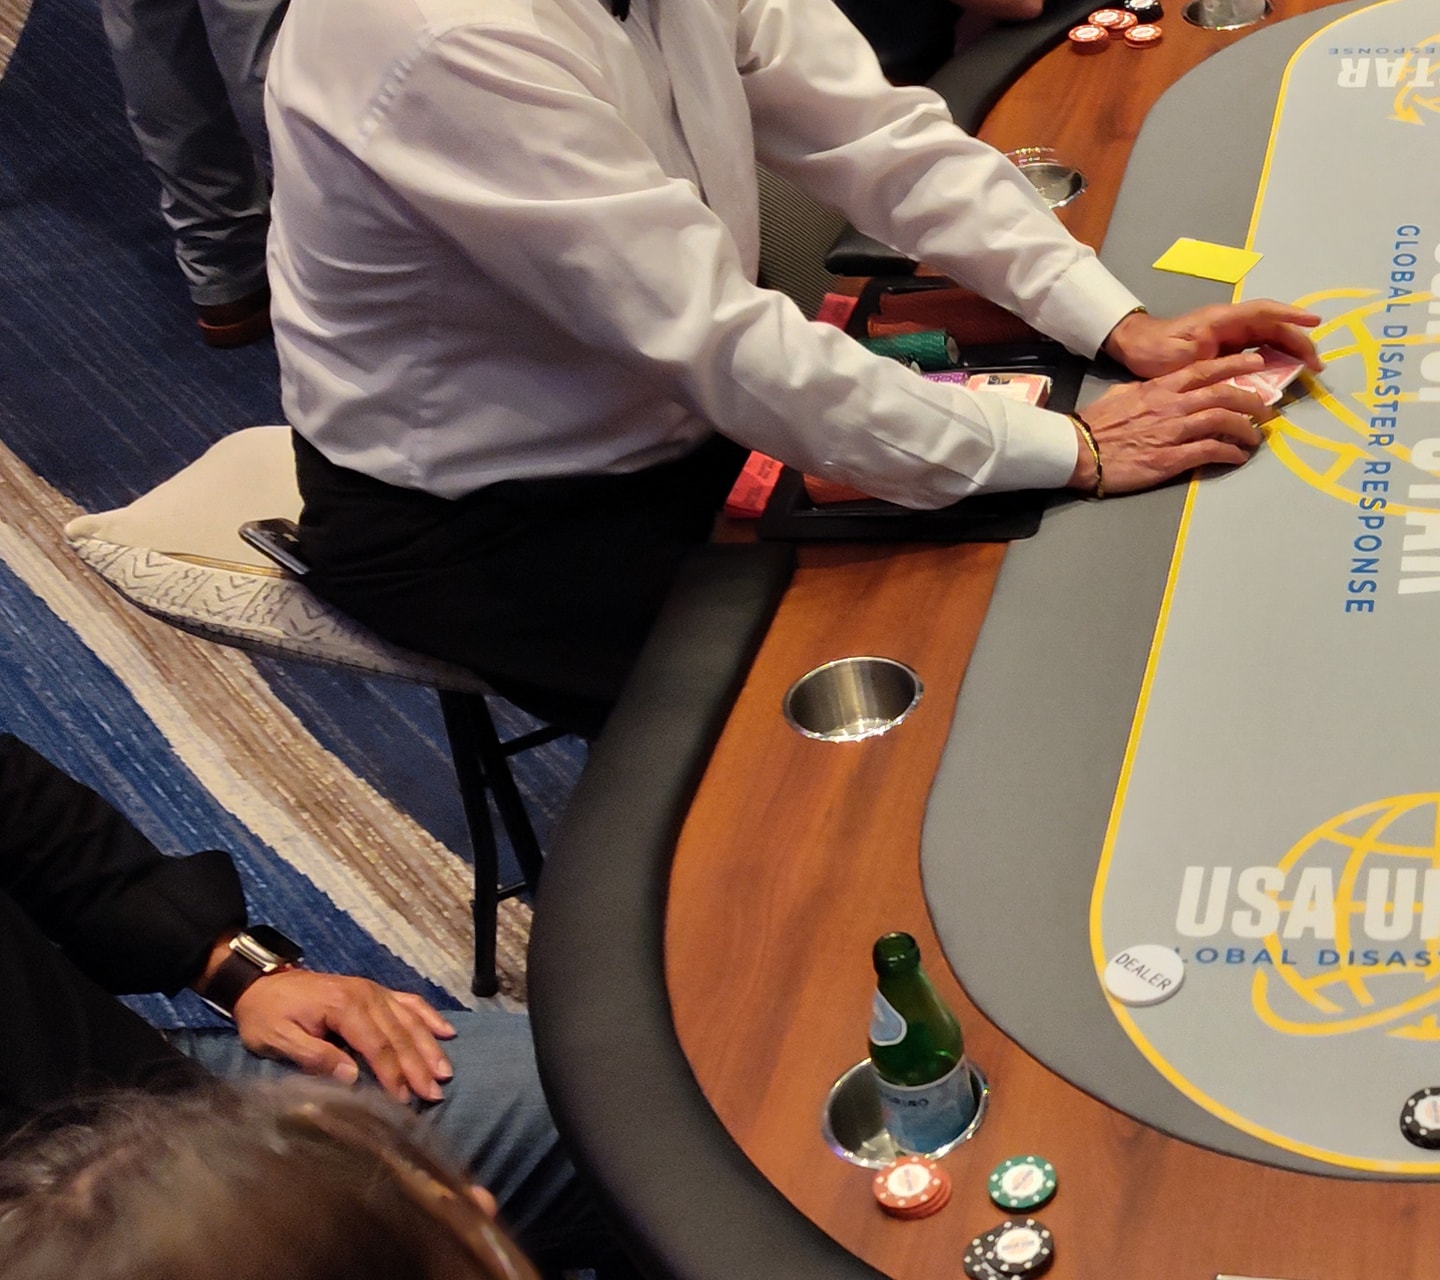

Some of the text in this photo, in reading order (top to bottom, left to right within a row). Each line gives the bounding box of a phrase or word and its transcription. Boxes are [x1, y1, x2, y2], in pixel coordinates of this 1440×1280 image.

[1344, 224, 1422, 614] GLOBAL DISASTER RESPONSE
[1175, 865, 1336, 940] USA
[1114, 952, 1173, 992] DEALER
